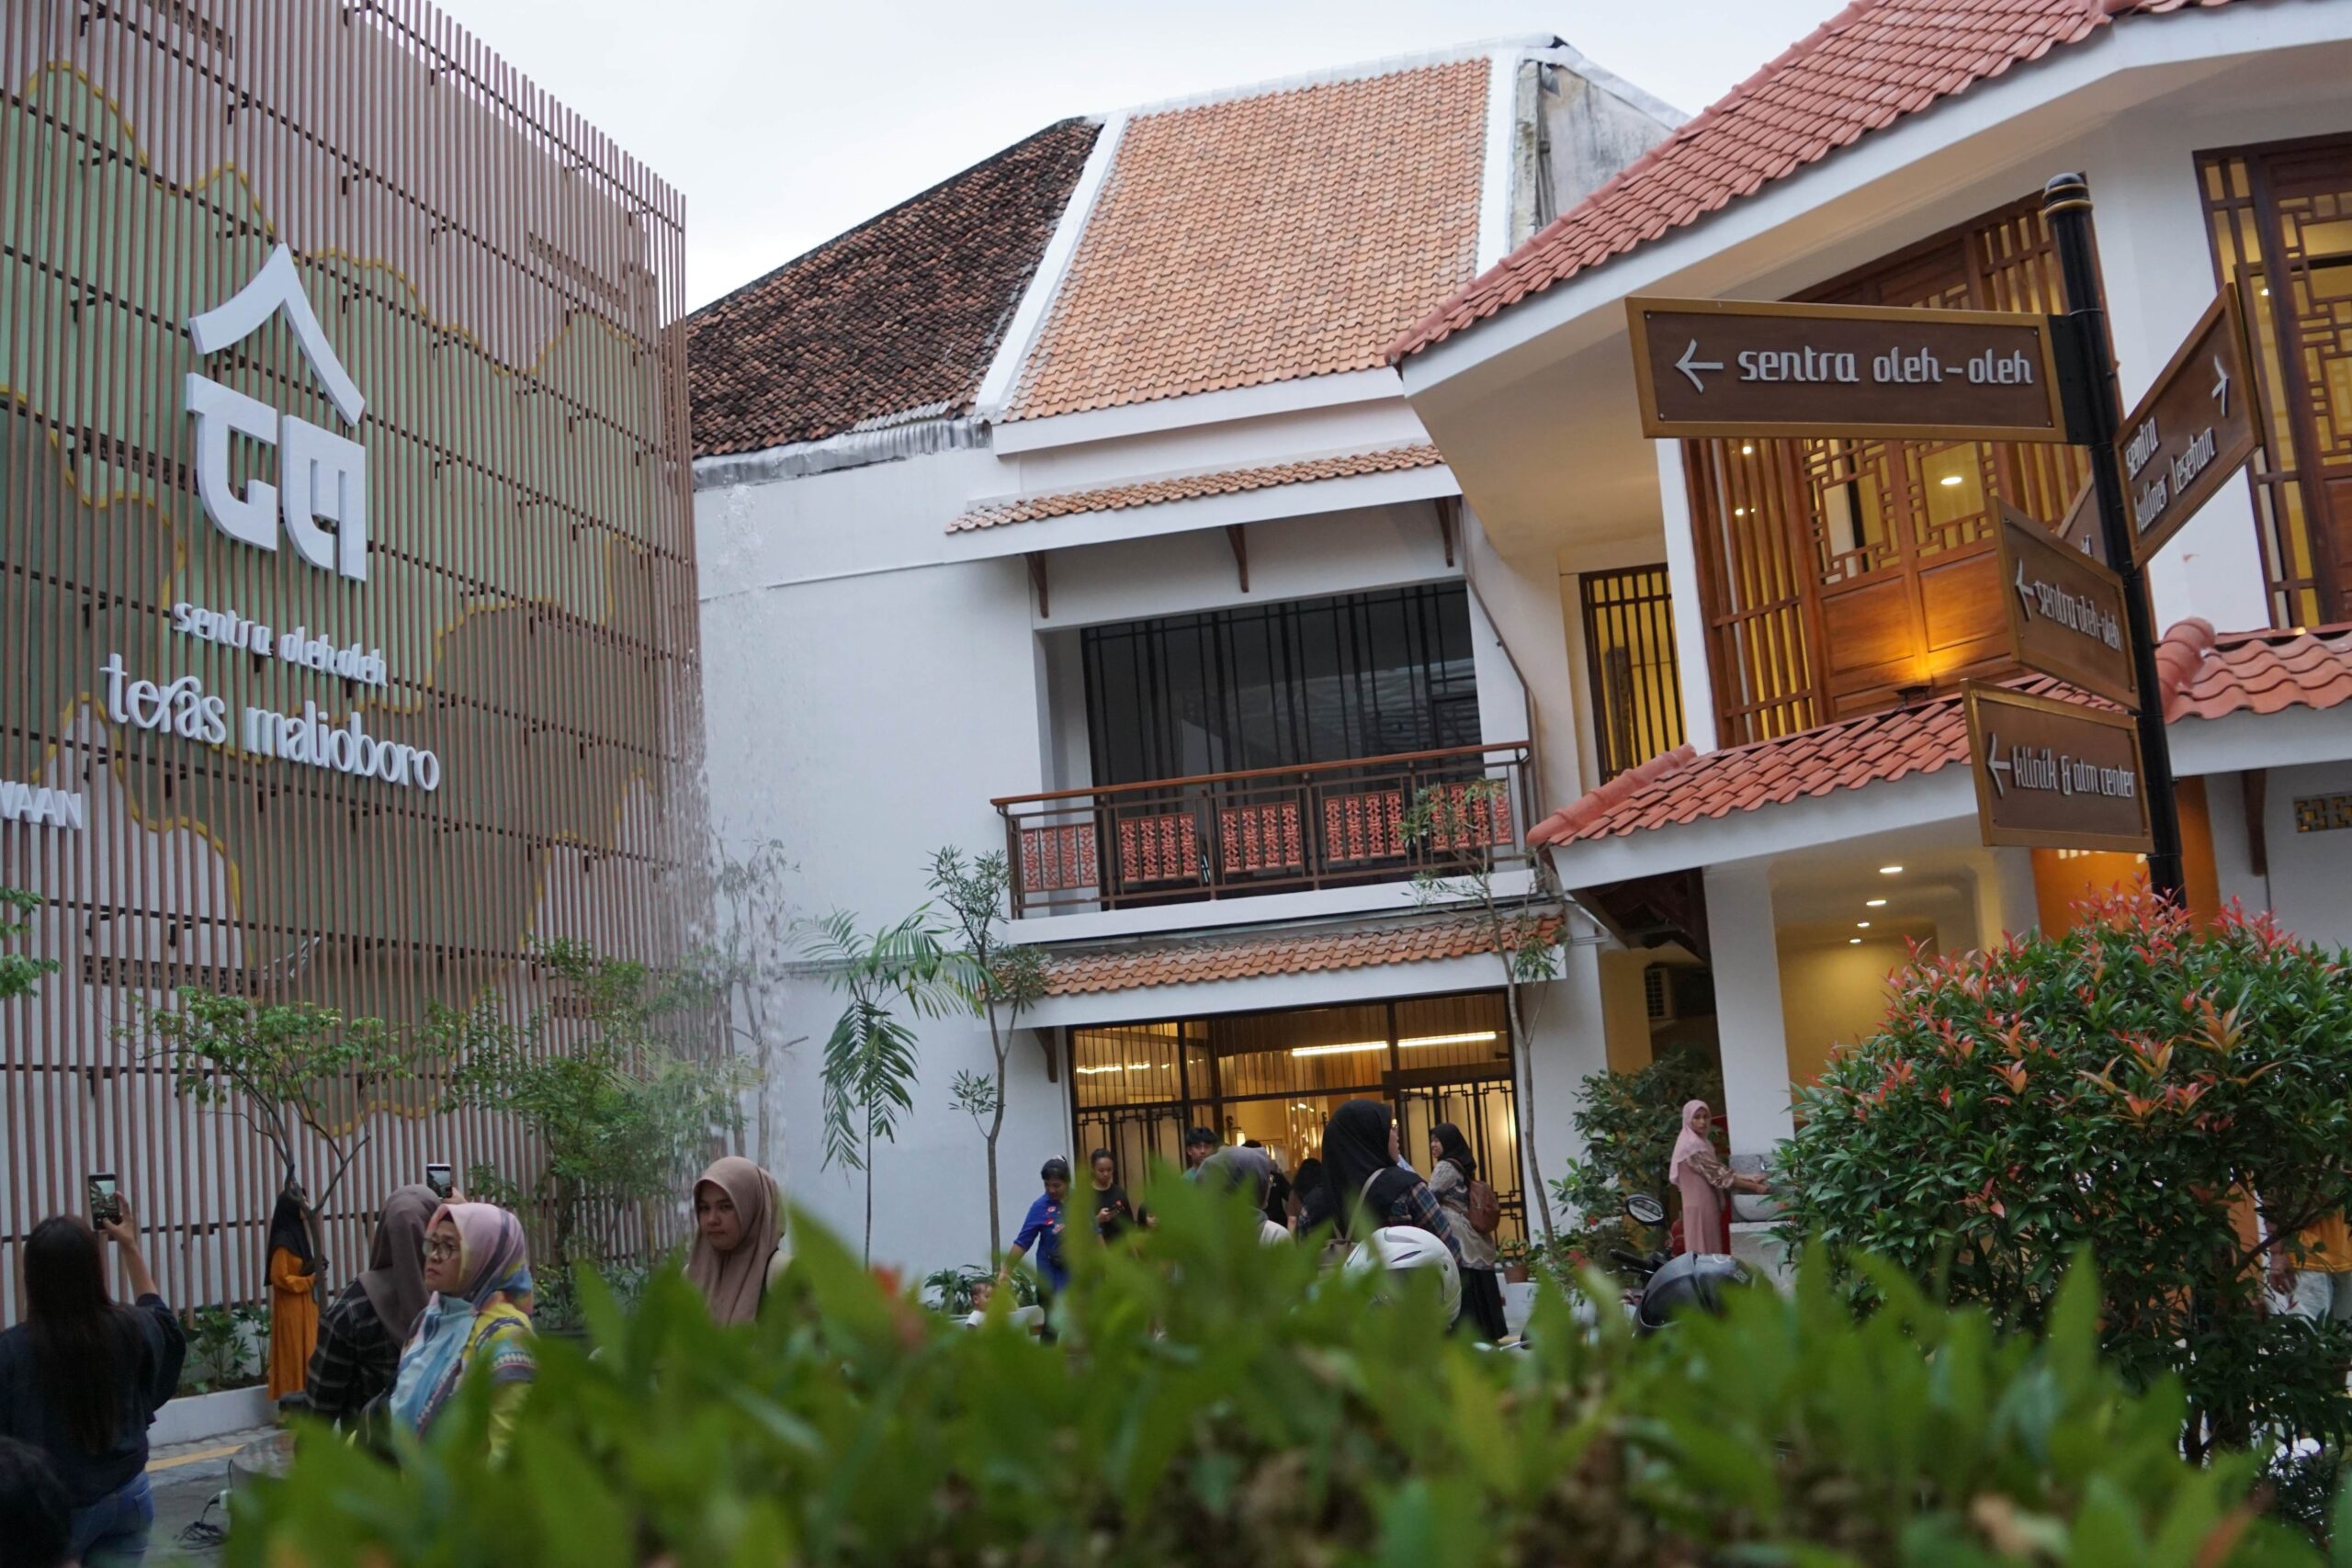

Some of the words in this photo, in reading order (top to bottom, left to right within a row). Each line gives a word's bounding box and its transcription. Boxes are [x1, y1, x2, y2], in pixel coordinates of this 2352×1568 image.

[1737, 345, 1860, 382] sentra
[1872, 346, 2034, 385] oleh-oleh
[2125, 416, 2160, 480] sentra
[2133, 474, 2169, 535] kuliner
[173, 602, 274, 656] sentra
[2033, 580, 2078, 631] sentra
[2075, 595, 2122, 652] oleh-oleh
[99, 653, 227, 744] teras
[245, 700, 441, 792] malioboro
[2011, 745, 2059, 790] klinik
[2072, 758, 2100, 794] atm
[2099, 764, 2136, 798] center
